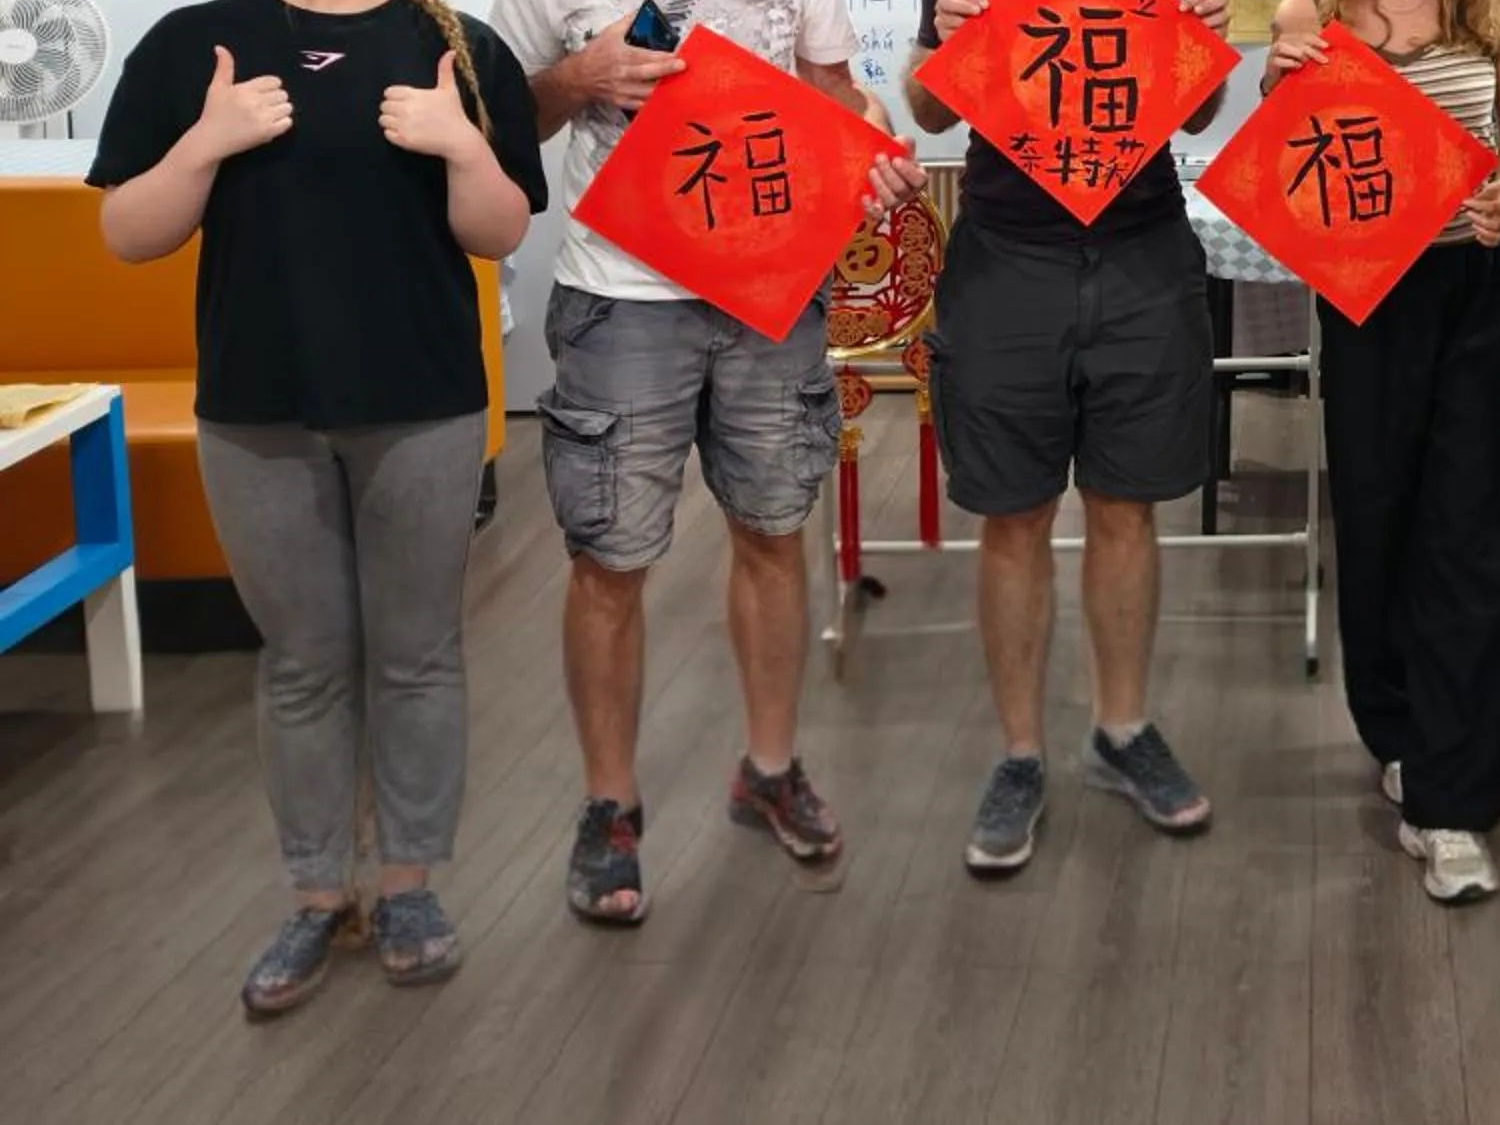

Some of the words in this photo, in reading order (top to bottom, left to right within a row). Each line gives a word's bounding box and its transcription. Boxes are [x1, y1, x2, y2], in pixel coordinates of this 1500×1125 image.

[1019, 6, 1139, 132] 福
[671, 111, 792, 231] 福
[1287, 114, 1394, 228] 福
